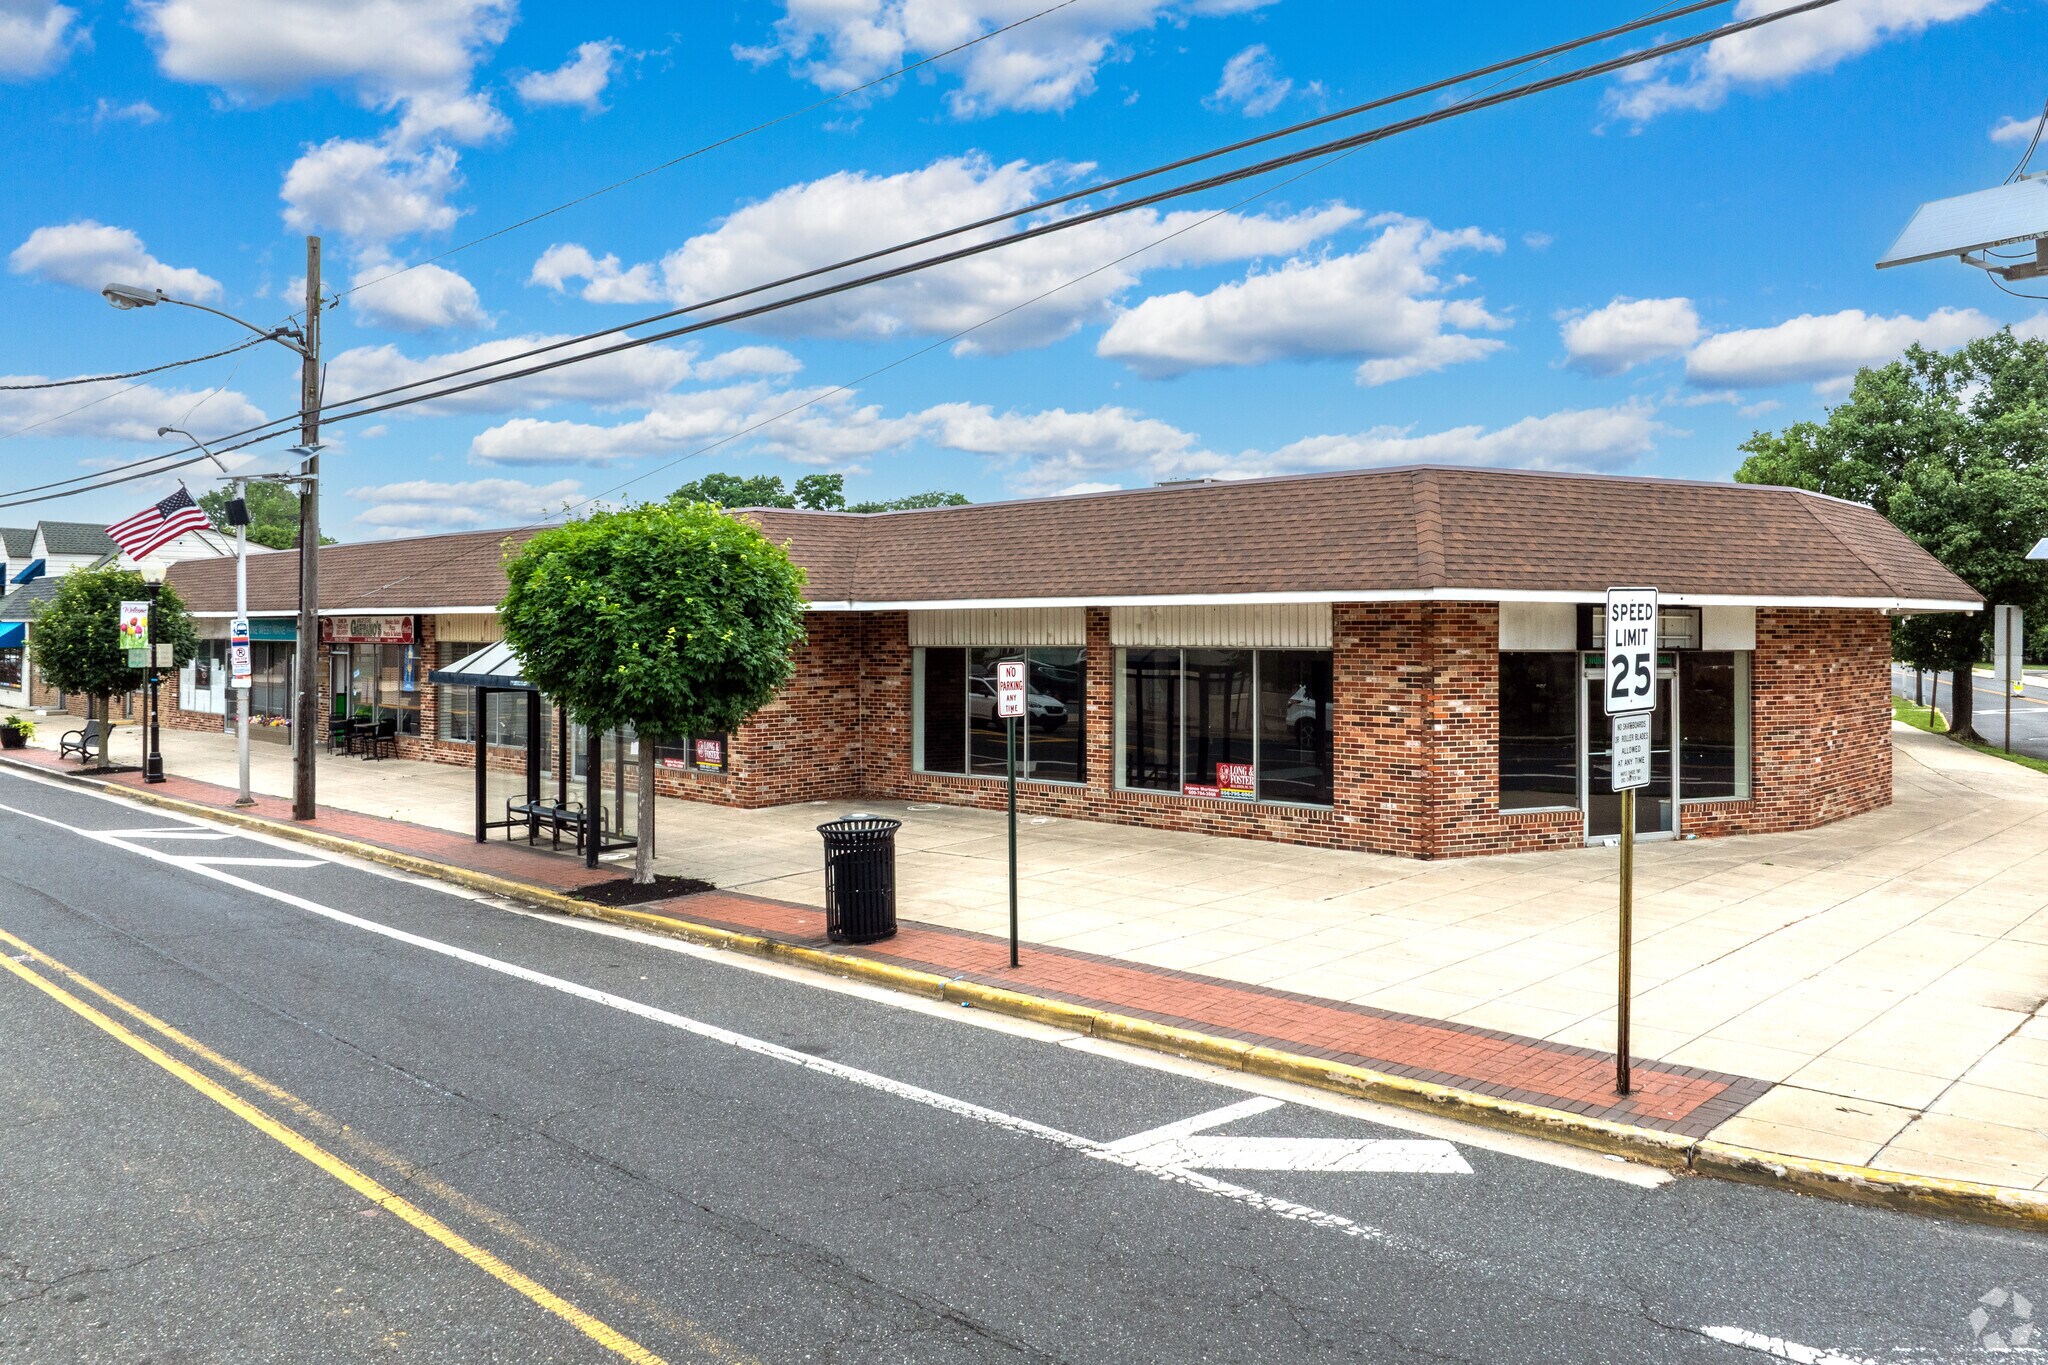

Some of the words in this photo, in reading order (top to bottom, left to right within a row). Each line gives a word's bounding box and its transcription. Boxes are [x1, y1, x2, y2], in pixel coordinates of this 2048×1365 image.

[1612, 603, 1653, 621] SPEED
[1616, 628, 1648, 646] LIMIT
[1006, 667, 1016, 677] NO
[1611, 653, 1651, 698] 25
[1000, 681, 1022, 691] PARKING
[1623, 721, 1646, 730] SKATEBOARDS
[1622, 734, 1633, 742] ROLLER
[1635, 732, 1648, 740] BLADES
[1622, 745, 1641, 754] ALLOWED
[1635, 756, 1645, 764] TIME
[1230, 766, 1247, 776] LONG
[1248, 766, 1254, 776] &
[1230, 775, 1254, 785] FOSTER
